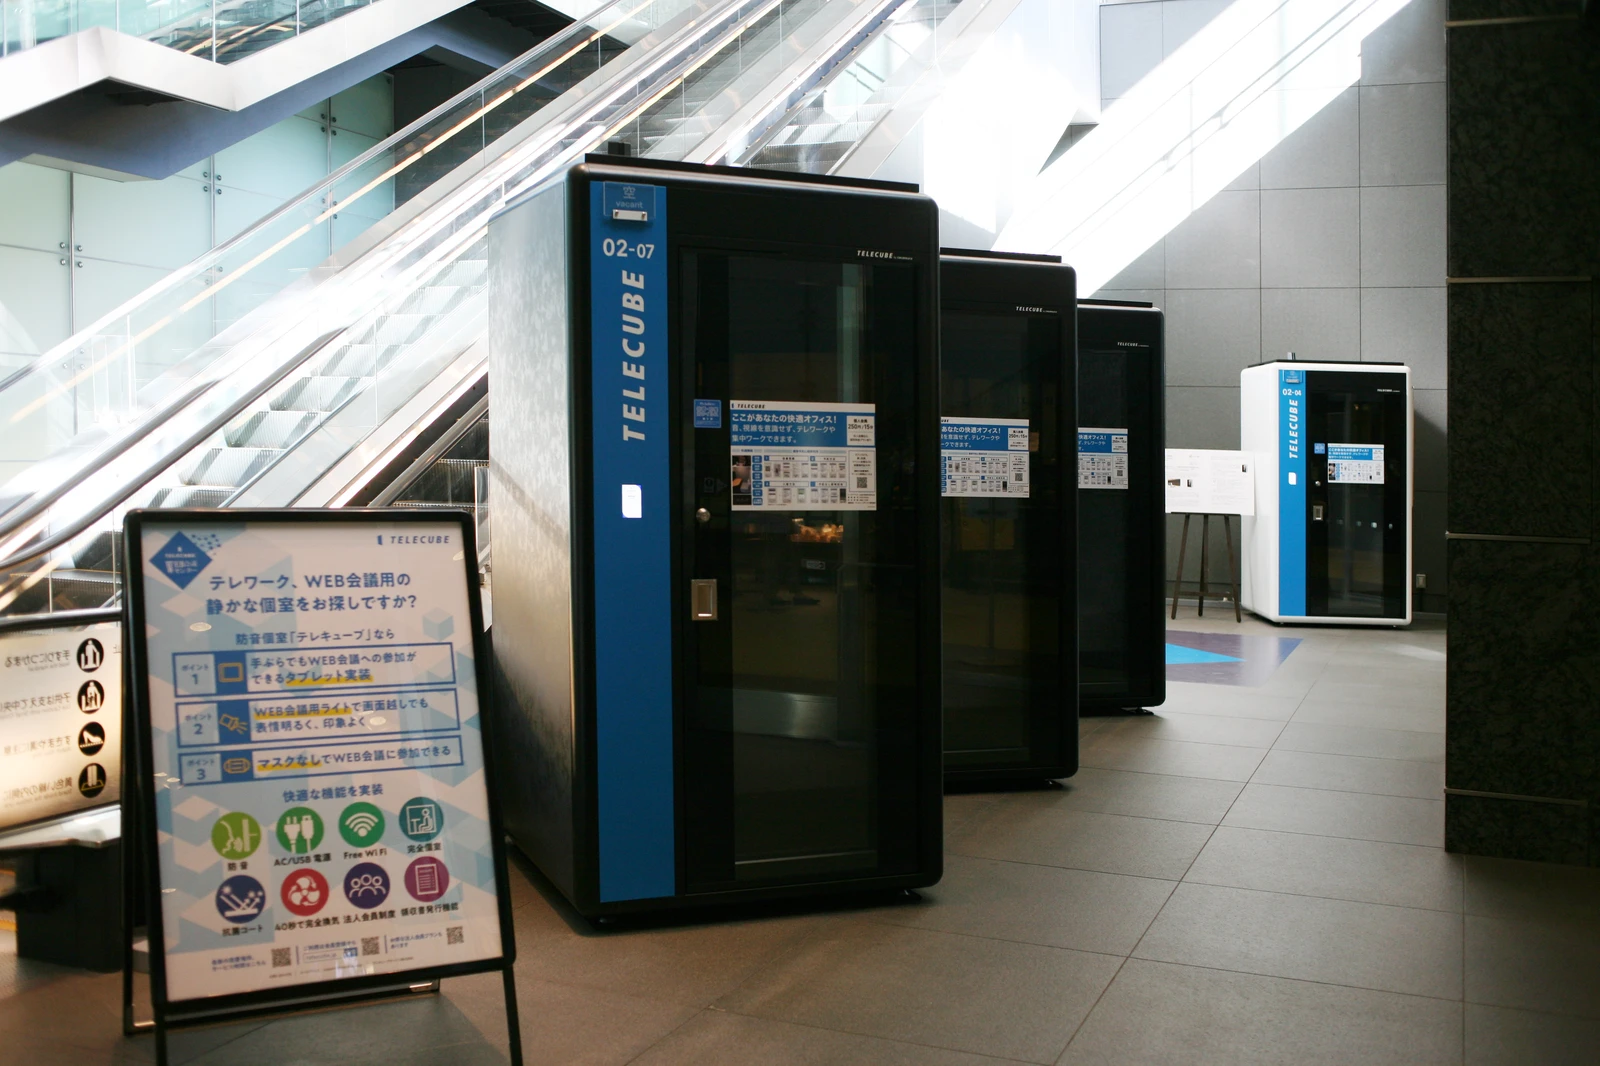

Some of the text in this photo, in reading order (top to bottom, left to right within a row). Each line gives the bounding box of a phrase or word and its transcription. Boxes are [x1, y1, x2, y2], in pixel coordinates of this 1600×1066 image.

[616, 201, 643, 209] vacant
[602, 238, 655, 259] 02-07
[857, 250, 894, 259] TELECUBE
[622, 270, 645, 441] TELECUBE
[1289, 399, 1298, 459] TELECUBE
[390, 535, 450, 544] TELECUBE
[235, 628, 395, 646] 防音個室「テレキューブ」なら
[251, 652, 416, 669] 手ぶらでもWEB会議への参加が
[192, 674, 199, 685] 1
[251, 669, 372, 685] できるタブレット実装
[254, 697, 429, 717] WEB会議用ライトで画面越しでも
[194, 724, 203, 735] 2
[257, 745, 451, 769] マスクなしでWEB会議に参加できる
[196, 768, 206, 780] 3
[283, 784, 383, 802] 快適な機能を実装
[274, 855, 312, 867] AC/USB
[343, 851, 362, 859] Free
[343, 910, 396, 924] 法人会員制度
